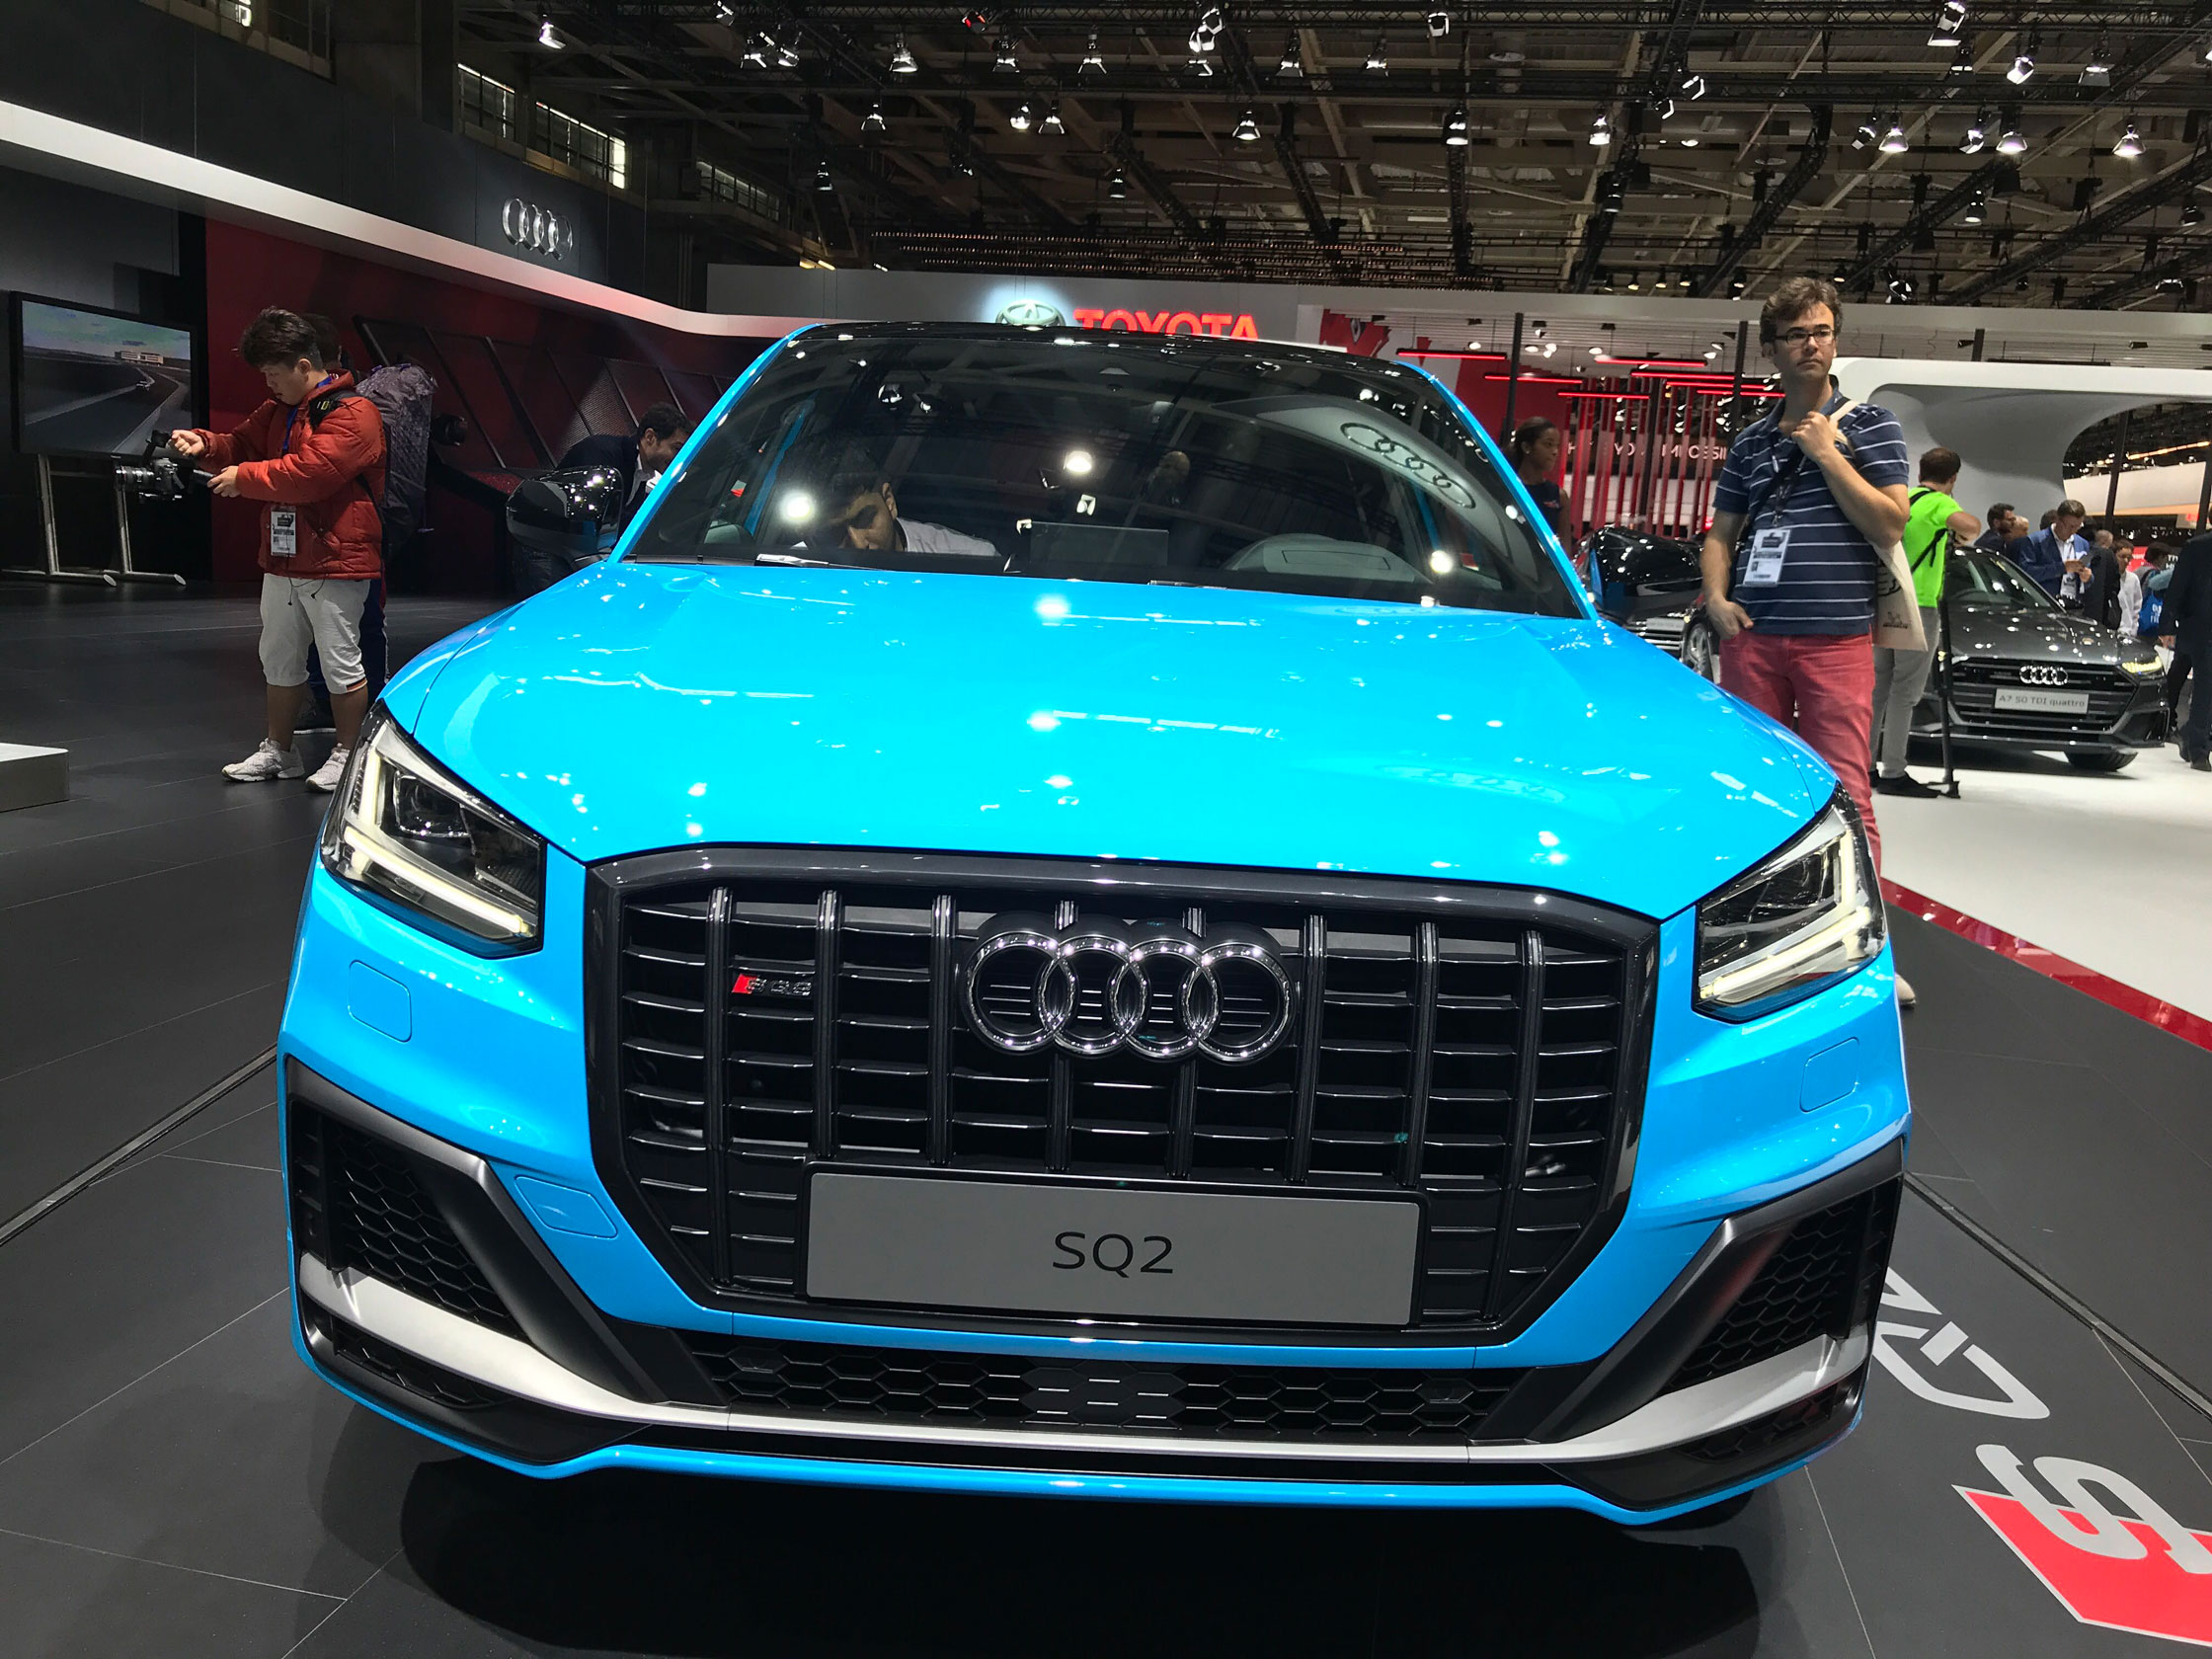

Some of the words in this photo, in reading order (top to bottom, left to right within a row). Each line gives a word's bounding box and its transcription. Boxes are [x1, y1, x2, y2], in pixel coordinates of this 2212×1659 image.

[1073, 308, 1259, 341] TOYOTA
[2049, 698, 2086, 708] quattro
[1052, 1230, 1174, 1279] SQ2
